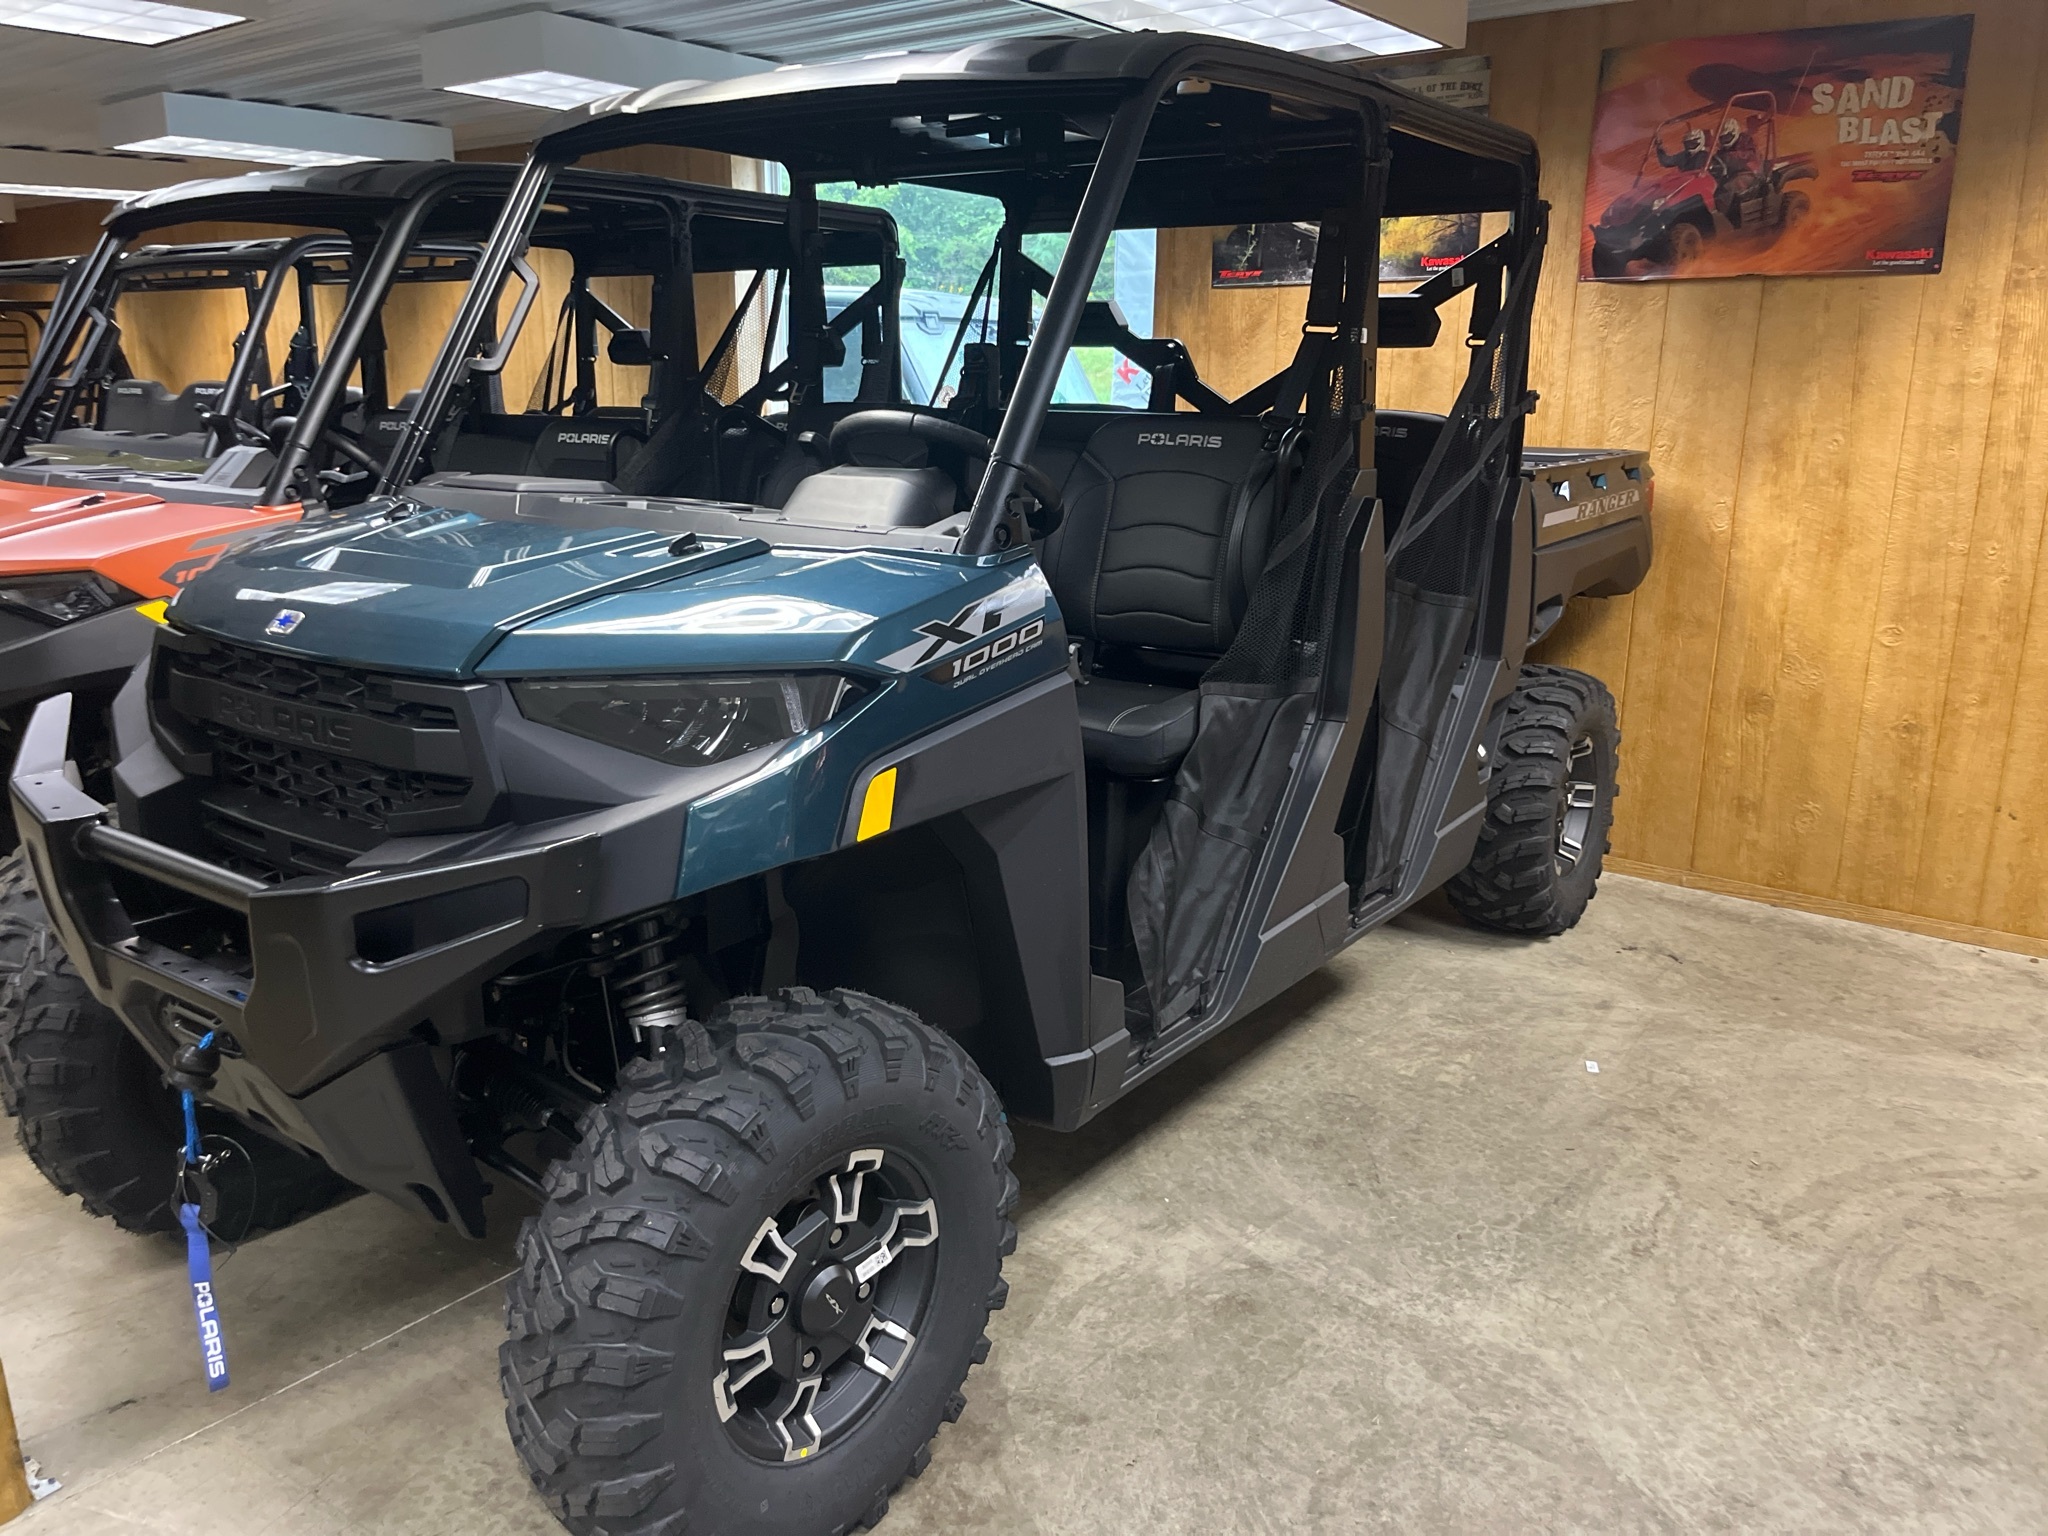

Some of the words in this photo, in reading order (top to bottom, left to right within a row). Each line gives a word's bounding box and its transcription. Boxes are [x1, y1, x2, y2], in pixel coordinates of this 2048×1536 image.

[1811, 76, 1915, 115] SAND
[1838, 111, 1944, 146] BLAST
[1420, 255, 1465, 267] Kawasa
[1865, 247, 1935, 260] Kawasaki
[379, 421, 407, 431] POLA
[558, 432, 610, 445] POLARIS
[1138, 433, 1223, 449] POLARIS
[1577, 488, 1636, 522] RANGER
[952, 618, 1045, 679] 1000
[953, 674, 977, 689] DUAL
[979, 650, 1025, 677] OVERHEAD
[1025, 639, 1044, 653] CAM
[217, 693, 353, 752] POLARIS
[193, 1281, 226, 1379] POLARIS
